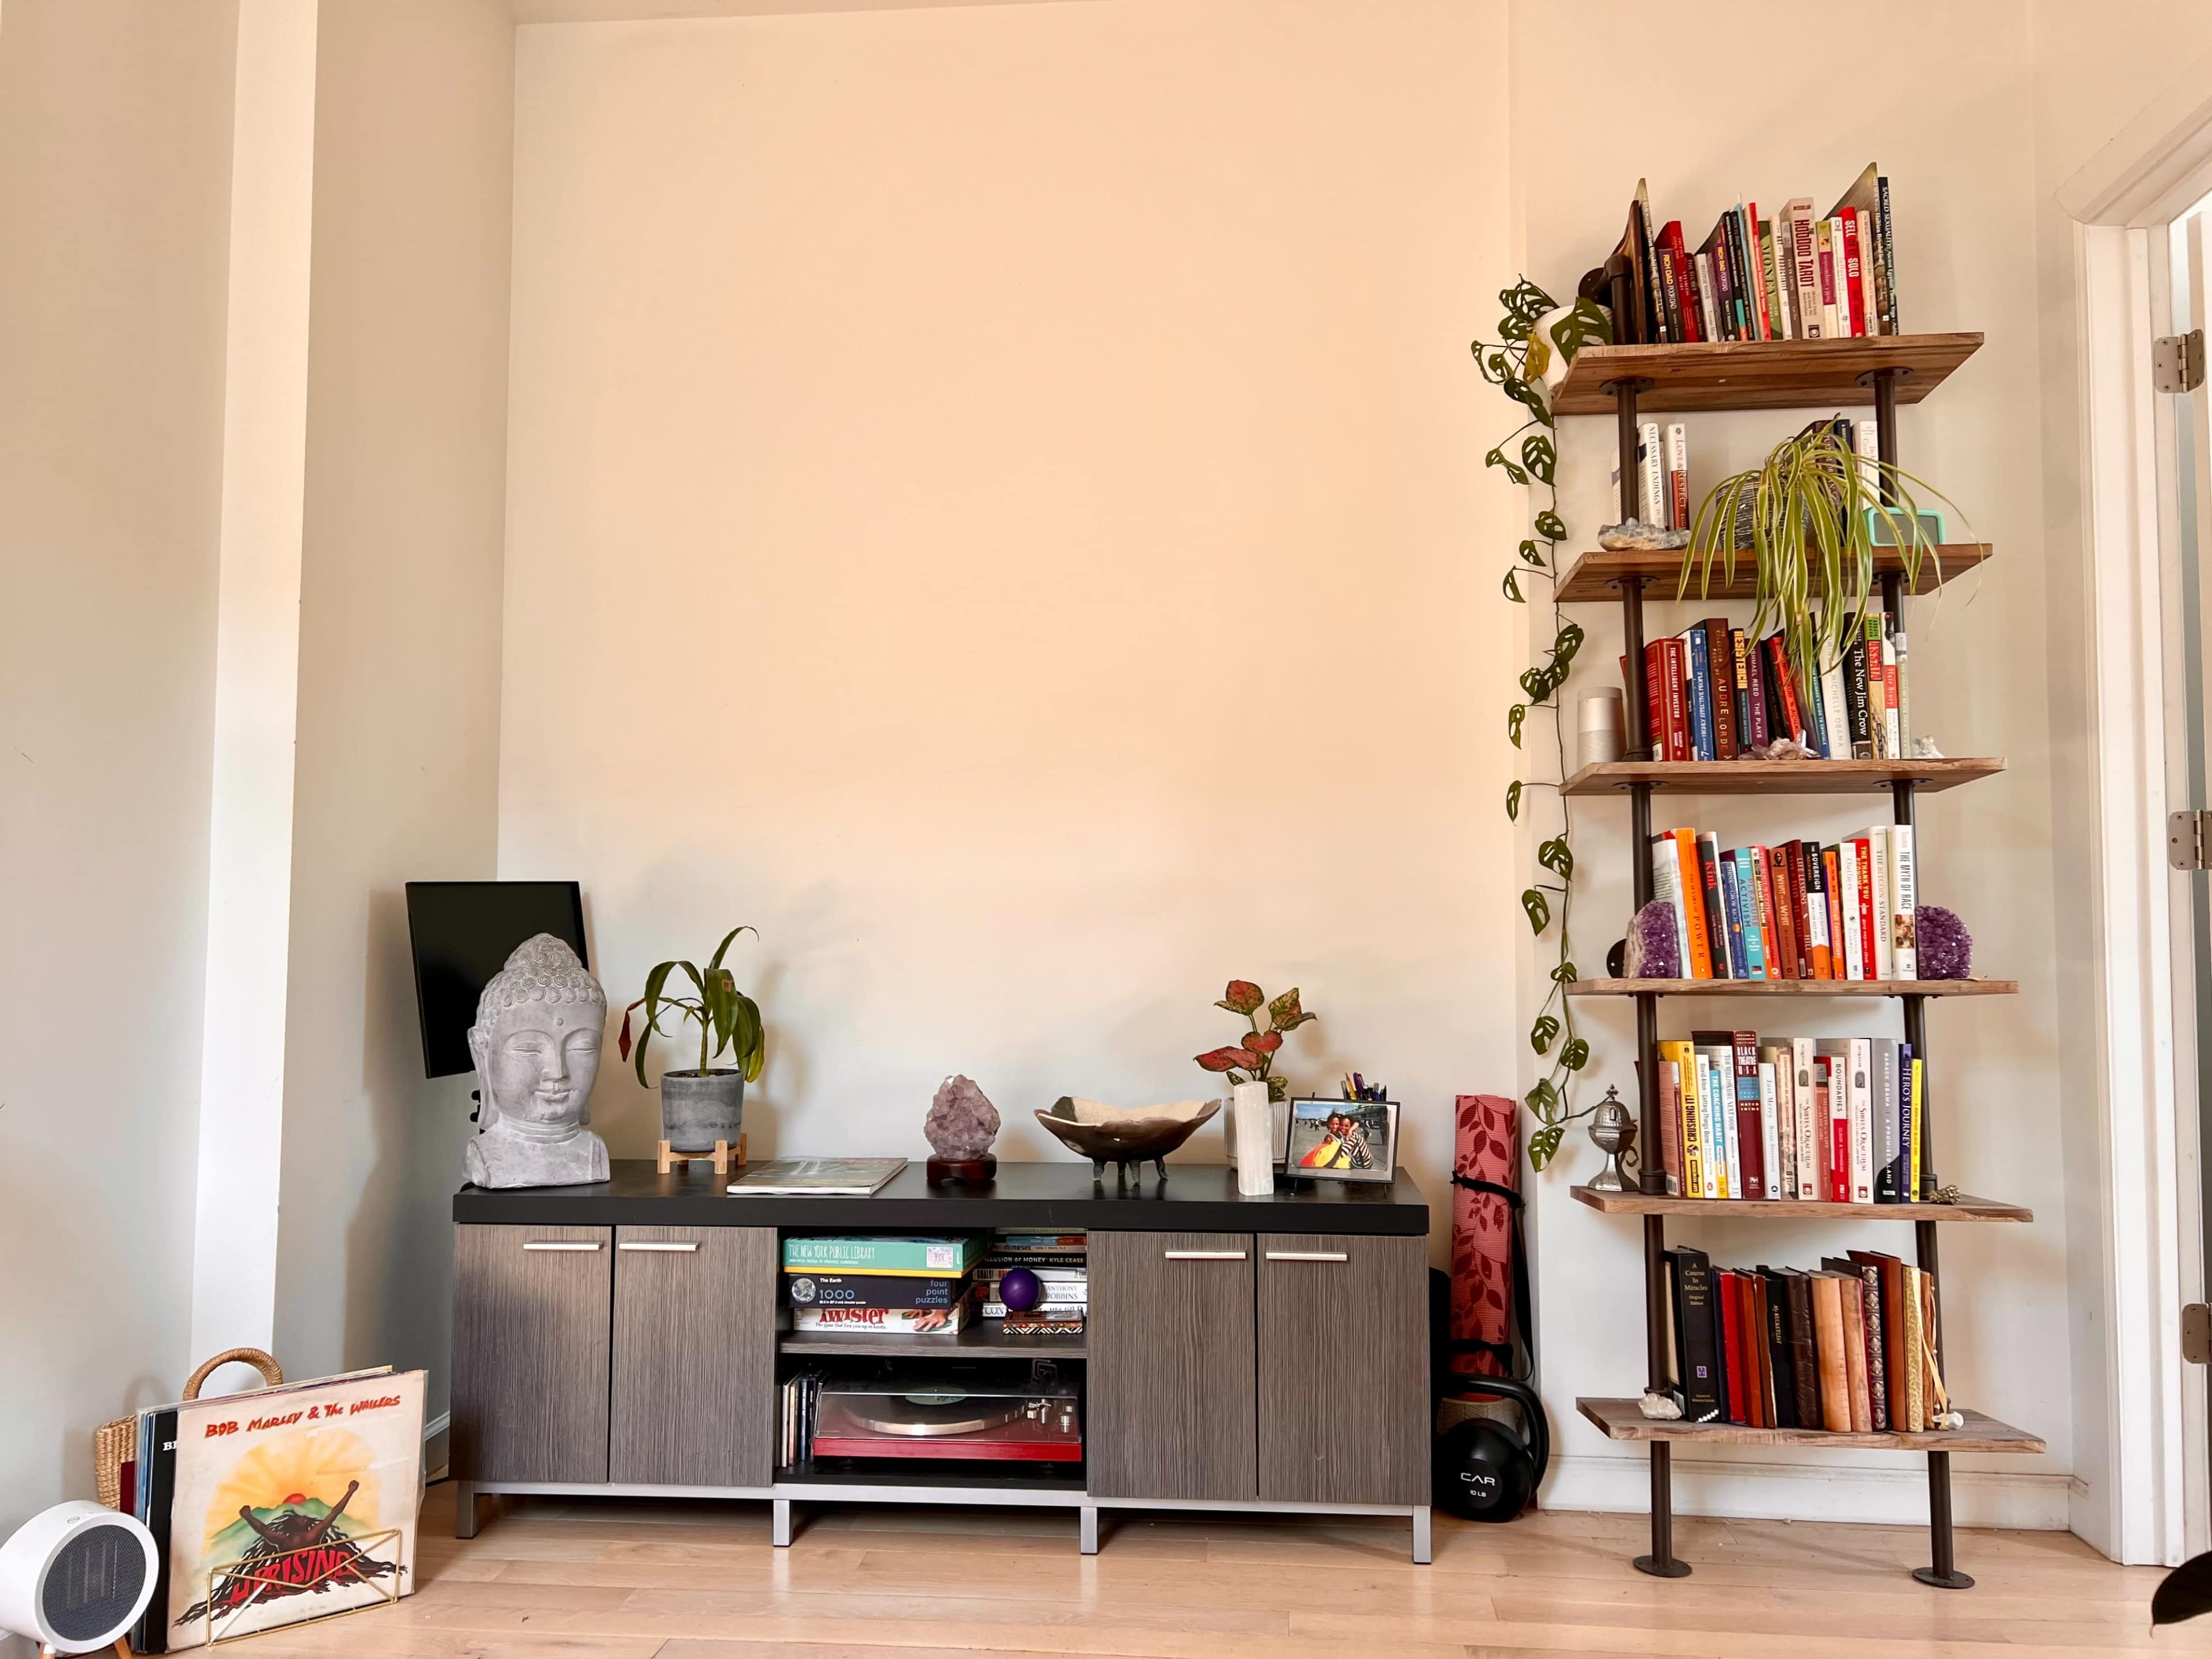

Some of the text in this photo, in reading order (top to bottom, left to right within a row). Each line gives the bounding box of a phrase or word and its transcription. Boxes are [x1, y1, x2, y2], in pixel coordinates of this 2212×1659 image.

[1845, 220, 1855, 238] SELL
[1663, 255, 1677, 309] RICH DAD DAD
[1762, 245, 1774, 297] MONEY
[1798, 259, 1814, 287] TAROT
[1649, 427, 1660, 505] NECESSARY ENDINGS
[1677, 471, 1686, 508] RESPECT
[1854, 649, 1863, 667] The
[1867, 642, 1881, 681] ASSATA
[1855, 669, 1865, 690] New
[1830, 675, 1843, 747] MICHELLE OBAMA
[1854, 692, 1866, 708] Jim
[1718, 679, 1728, 751] AUDRE LORDE
[1858, 710, 1868, 736] Crow
[1900, 852, 1911, 863] THE
[1705, 861, 1716, 890] Kink
[1812, 854, 1820, 890] SOVEREIGN
[1900, 865, 1911, 882] MYTH
[1748, 878, 1759, 927] PLEASURE
[1777, 874, 1789, 926] WHAT WHAT
[1798, 875, 1806, 905] LESSONS
[1901, 895, 1912, 910] RACE
[1740, 880, 1750, 927] ACTIVISM
[1693, 916, 1705, 959] POWER
[1737, 1046, 1756, 1056] BLACK
[1737, 1056, 1756, 1065] THEATRE
[1724, 1067, 1733, 1101] MILLIONAIRE
[1903, 1069, 1911, 1102] HERO'S
[1684, 1095, 1695, 1104] IT!
[1700, 1095, 1709, 1112] Getting
[1685, 1106, 1697, 1142] CRUSHING
[1702, 1114, 1710, 1130] Things
[789, 1244, 876, 1260] THE NEW YORK PUBLIC LIBRARY
[976, 1270, 994, 1279] GOALS!
[819, 1289, 855, 1300] 1000
[915, 1297, 948, 1306] puzzles
[926, 1287, 949, 1297] point
[819, 1308, 889, 1324] Twister
[984, 1306, 1005, 1315] COX
[204, 1395, 402, 1439] BOB MARLEY & The WAILERS
